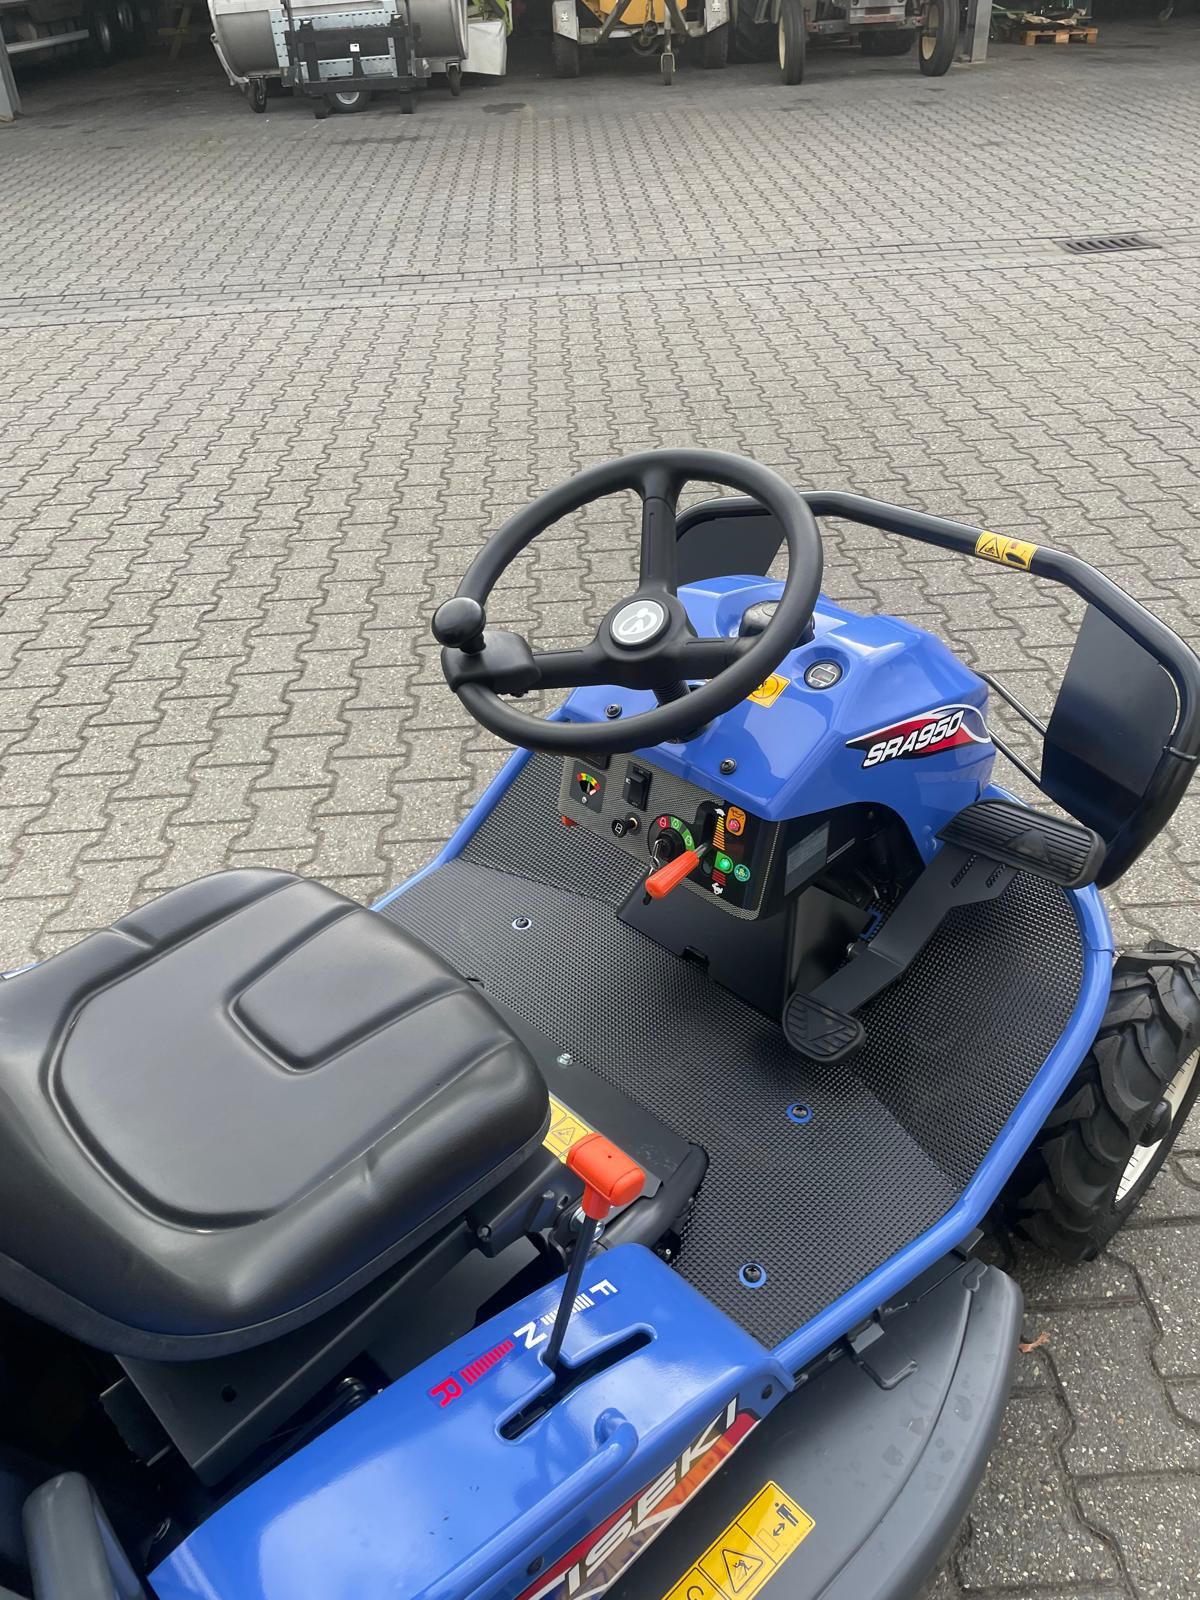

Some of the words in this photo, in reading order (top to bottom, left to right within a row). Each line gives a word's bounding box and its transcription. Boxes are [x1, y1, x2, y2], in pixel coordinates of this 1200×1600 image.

[863, 710, 965, 767] SRA950
[589, 1279, 618, 1296] F
[513, 1321, 548, 1350] N
[430, 1376, 463, 1408] R
[567, 1397, 737, 1596] ISEKI
